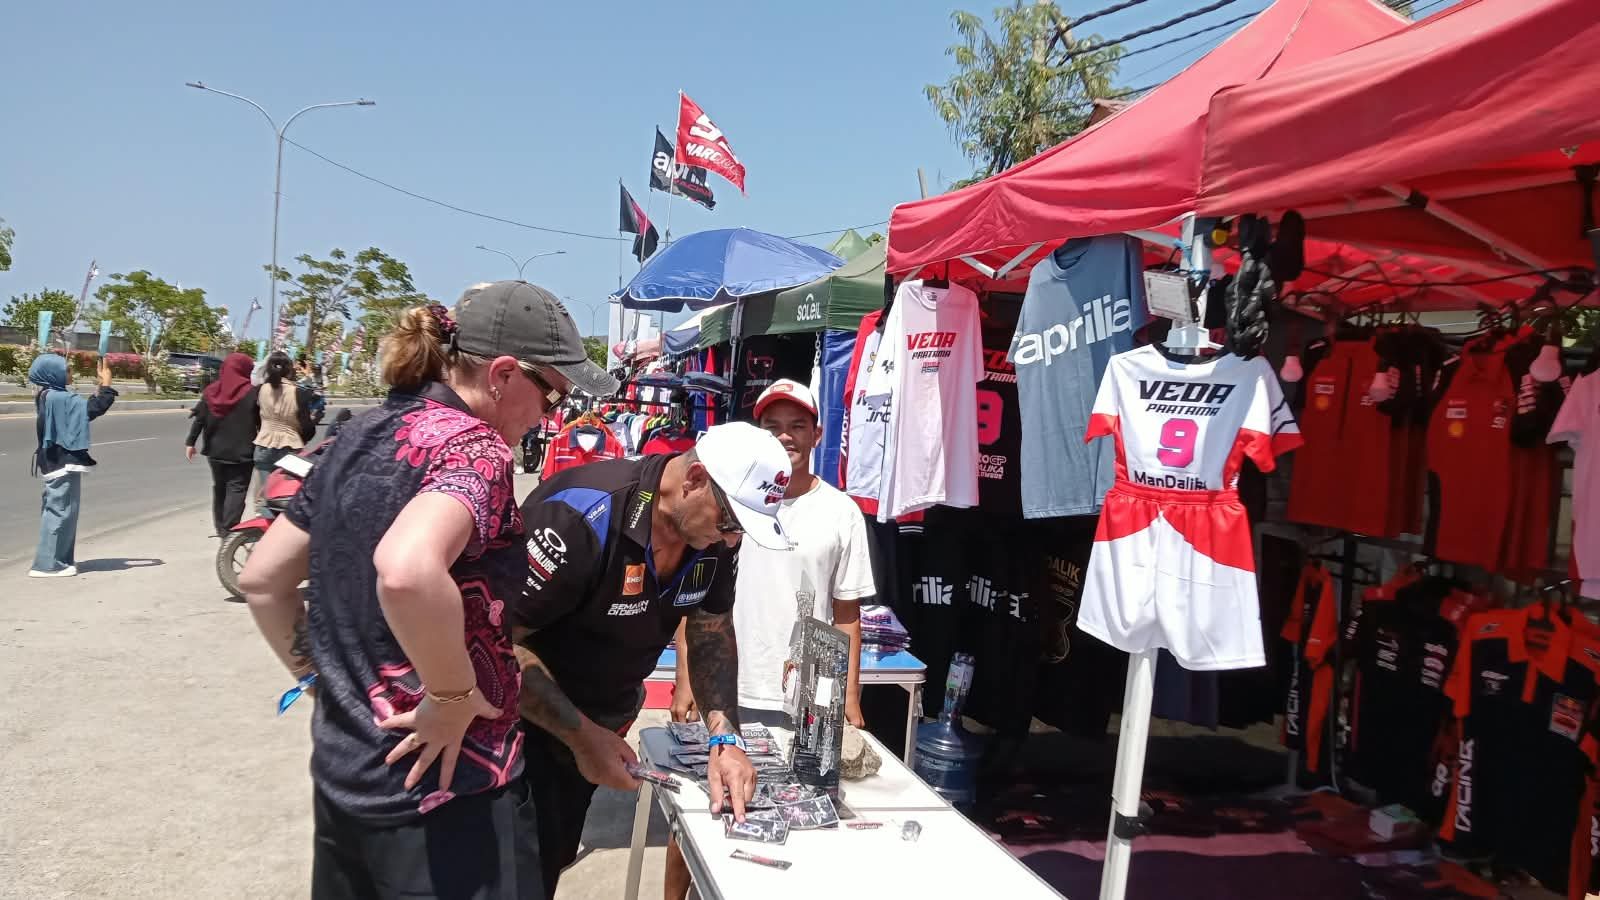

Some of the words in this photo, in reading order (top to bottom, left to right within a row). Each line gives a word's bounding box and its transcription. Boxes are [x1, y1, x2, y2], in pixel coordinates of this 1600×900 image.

[906, 331, 957, 351] VEDA
[1013, 294, 1132, 367] aprilia
[911, 350, 952, 360] PRATAMA
[1139, 380, 1237, 404] VEDA
[1145, 403, 1221, 417] PRATAMA
[1156, 418, 1199, 469] 9
[978, 463, 1005, 474] ALIKA
[526, 537, 559, 575] YAMALUBE
[534, 528, 568, 564] OAKLEY
